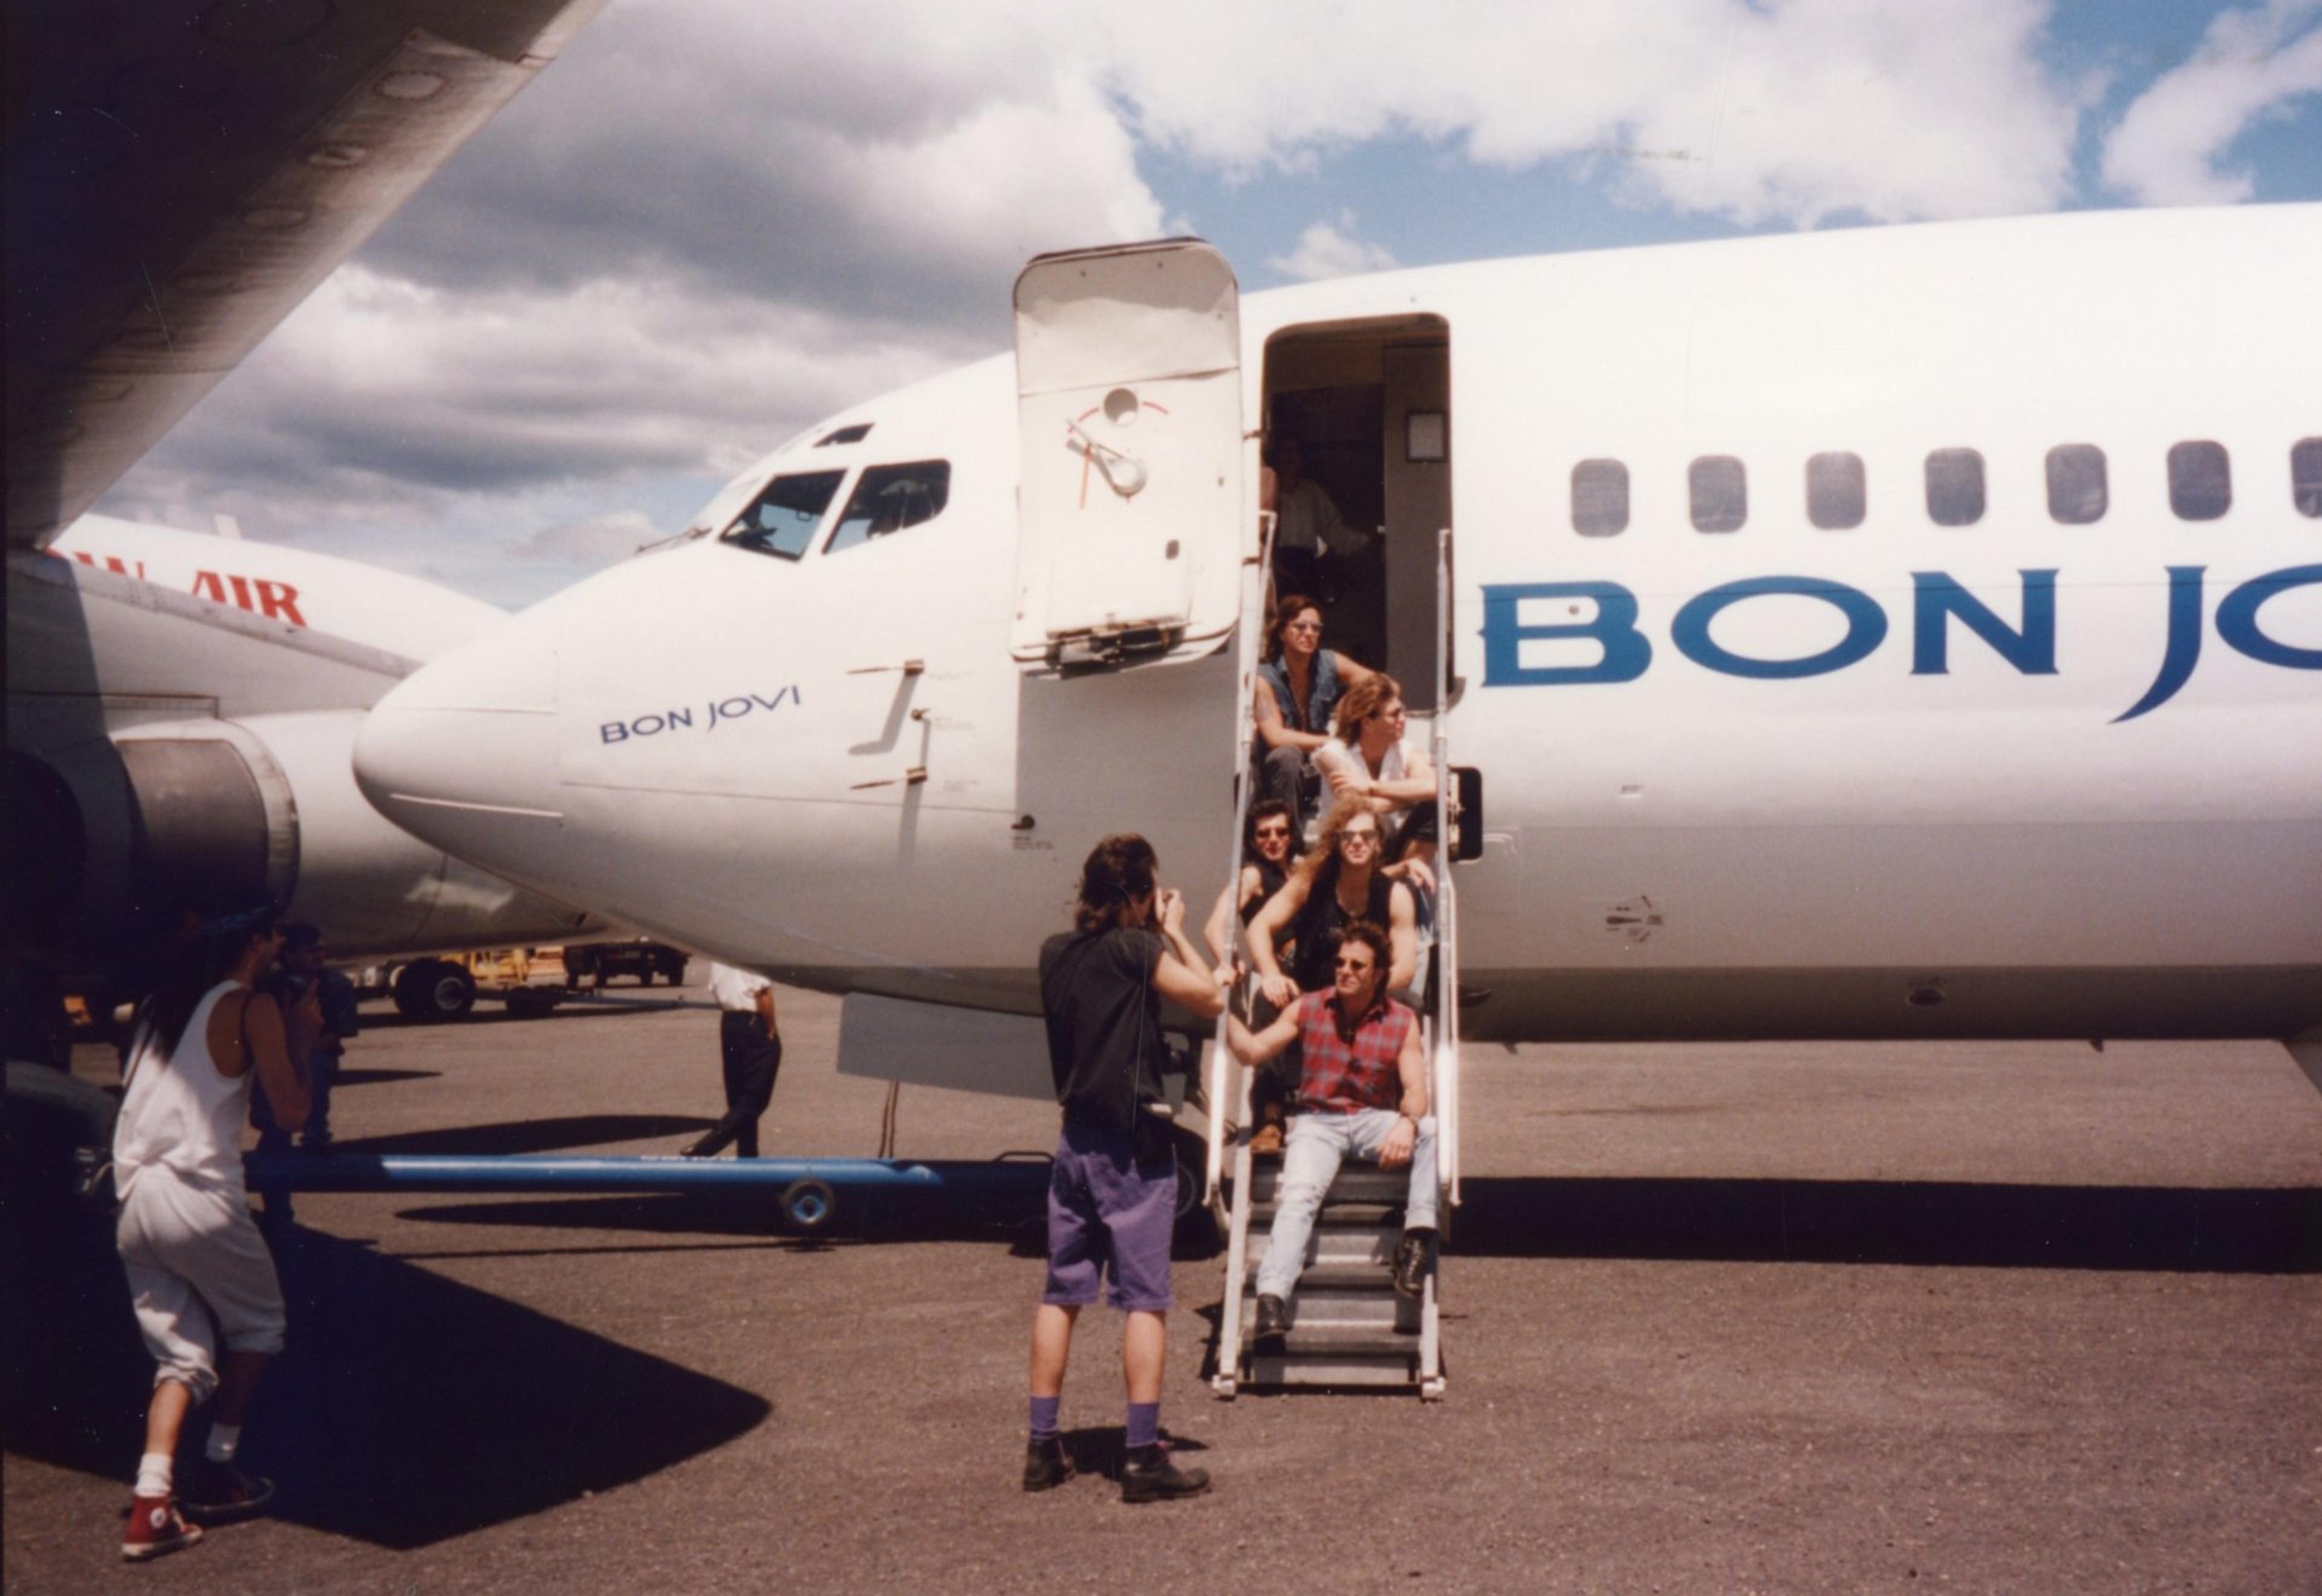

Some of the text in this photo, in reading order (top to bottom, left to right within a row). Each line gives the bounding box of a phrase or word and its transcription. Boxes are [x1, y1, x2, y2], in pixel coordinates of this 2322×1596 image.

[191, 569, 307, 628] AIR
[1478, 568, 2059, 688] BON
[600, 686, 800, 744] BON JOVI
